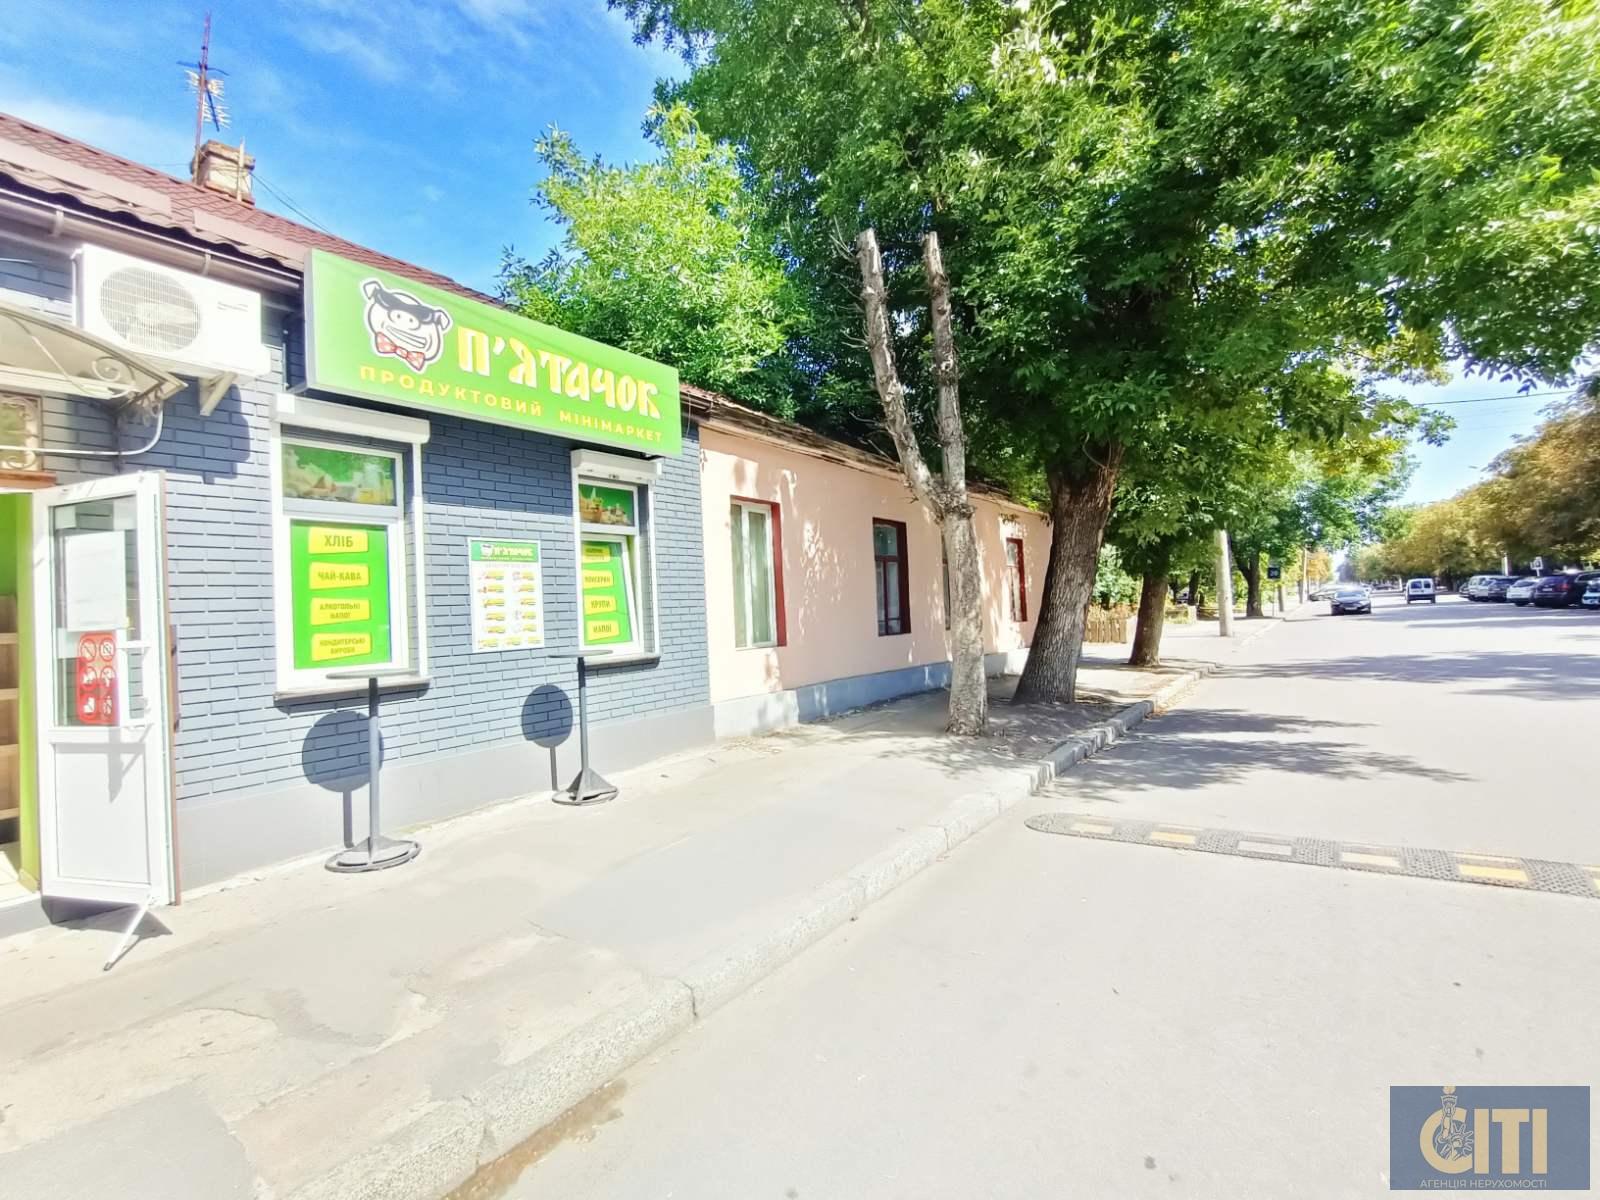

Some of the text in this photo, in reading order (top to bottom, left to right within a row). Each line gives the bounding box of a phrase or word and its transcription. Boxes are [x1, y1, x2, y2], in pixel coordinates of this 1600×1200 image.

[457, 327, 662, 420] П'ЯТАЧОК
[360, 365, 663, 443] ПРОДУКТОВИЙ МІНІМАРКЕТ
[324, 534, 354, 548] ХЛІБ
[317, 570, 362, 582] ЧАЙ-КАВА
